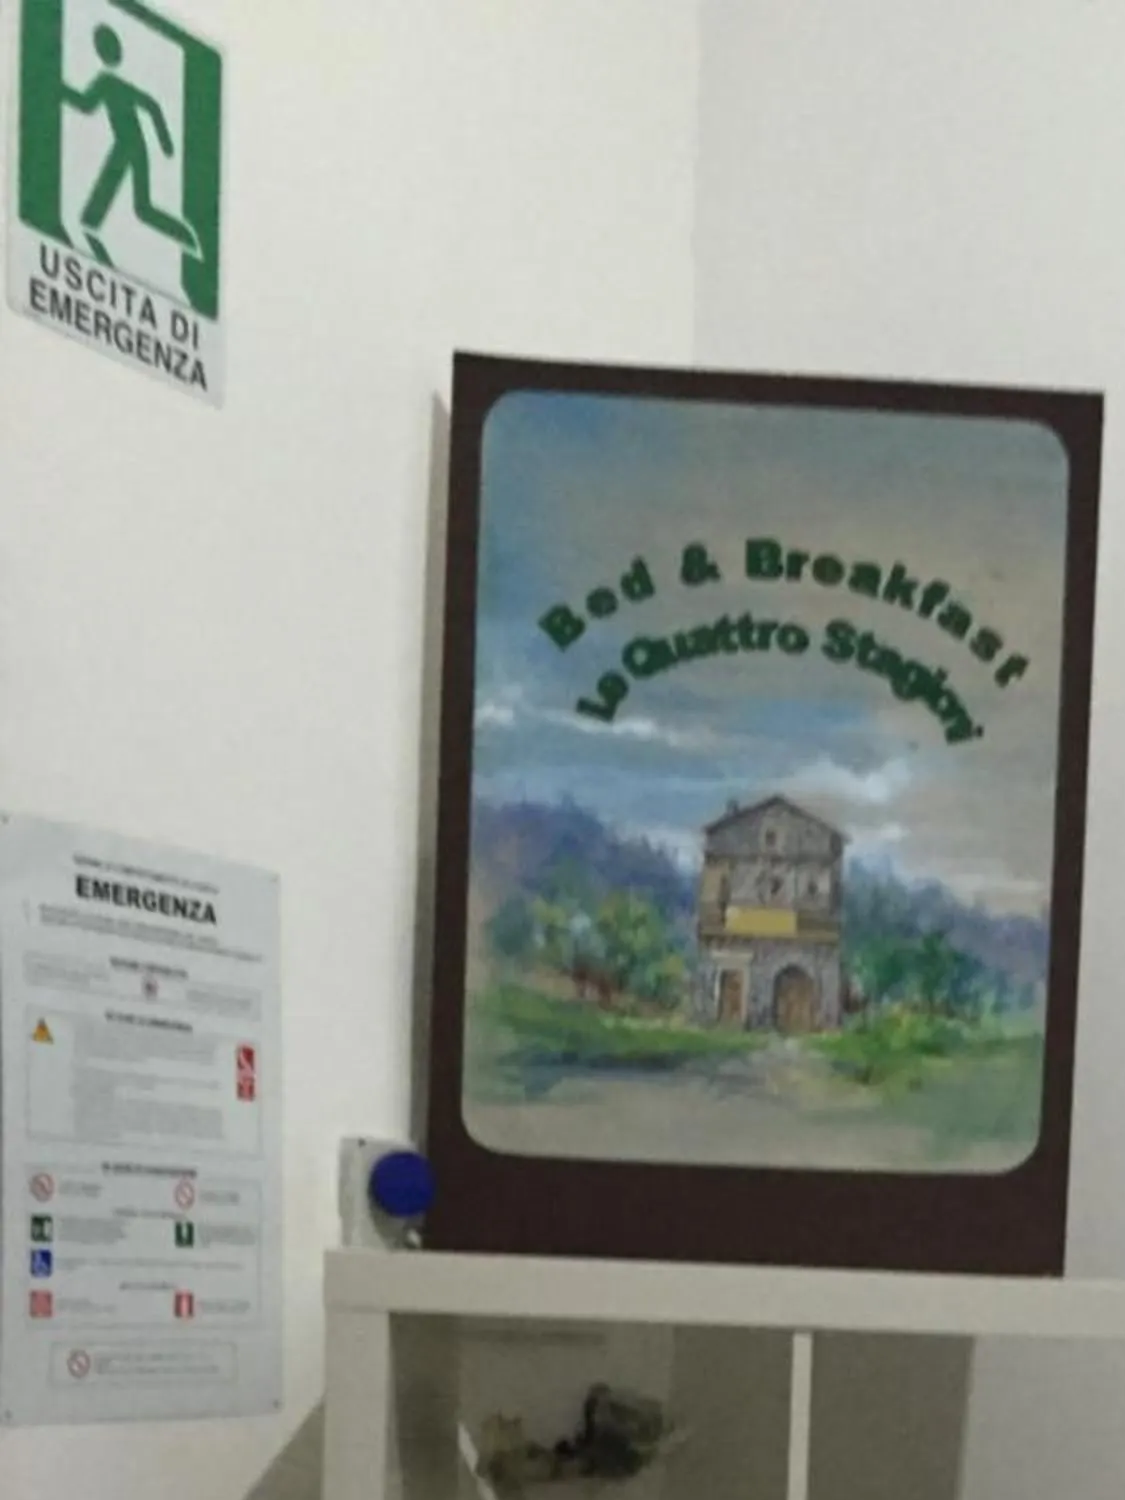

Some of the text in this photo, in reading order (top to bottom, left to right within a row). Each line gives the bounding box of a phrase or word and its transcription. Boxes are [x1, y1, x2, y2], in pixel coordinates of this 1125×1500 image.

[29, 276, 208, 392] EMERGENZA
[38, 241, 200, 351] USCITA DI
[537, 537, 1029, 688] Bed & Breakfast
[575, 670, 629, 723] Le
[621, 611, 810, 679] Quattro
[75, 873, 217, 925] EMERGENZA
